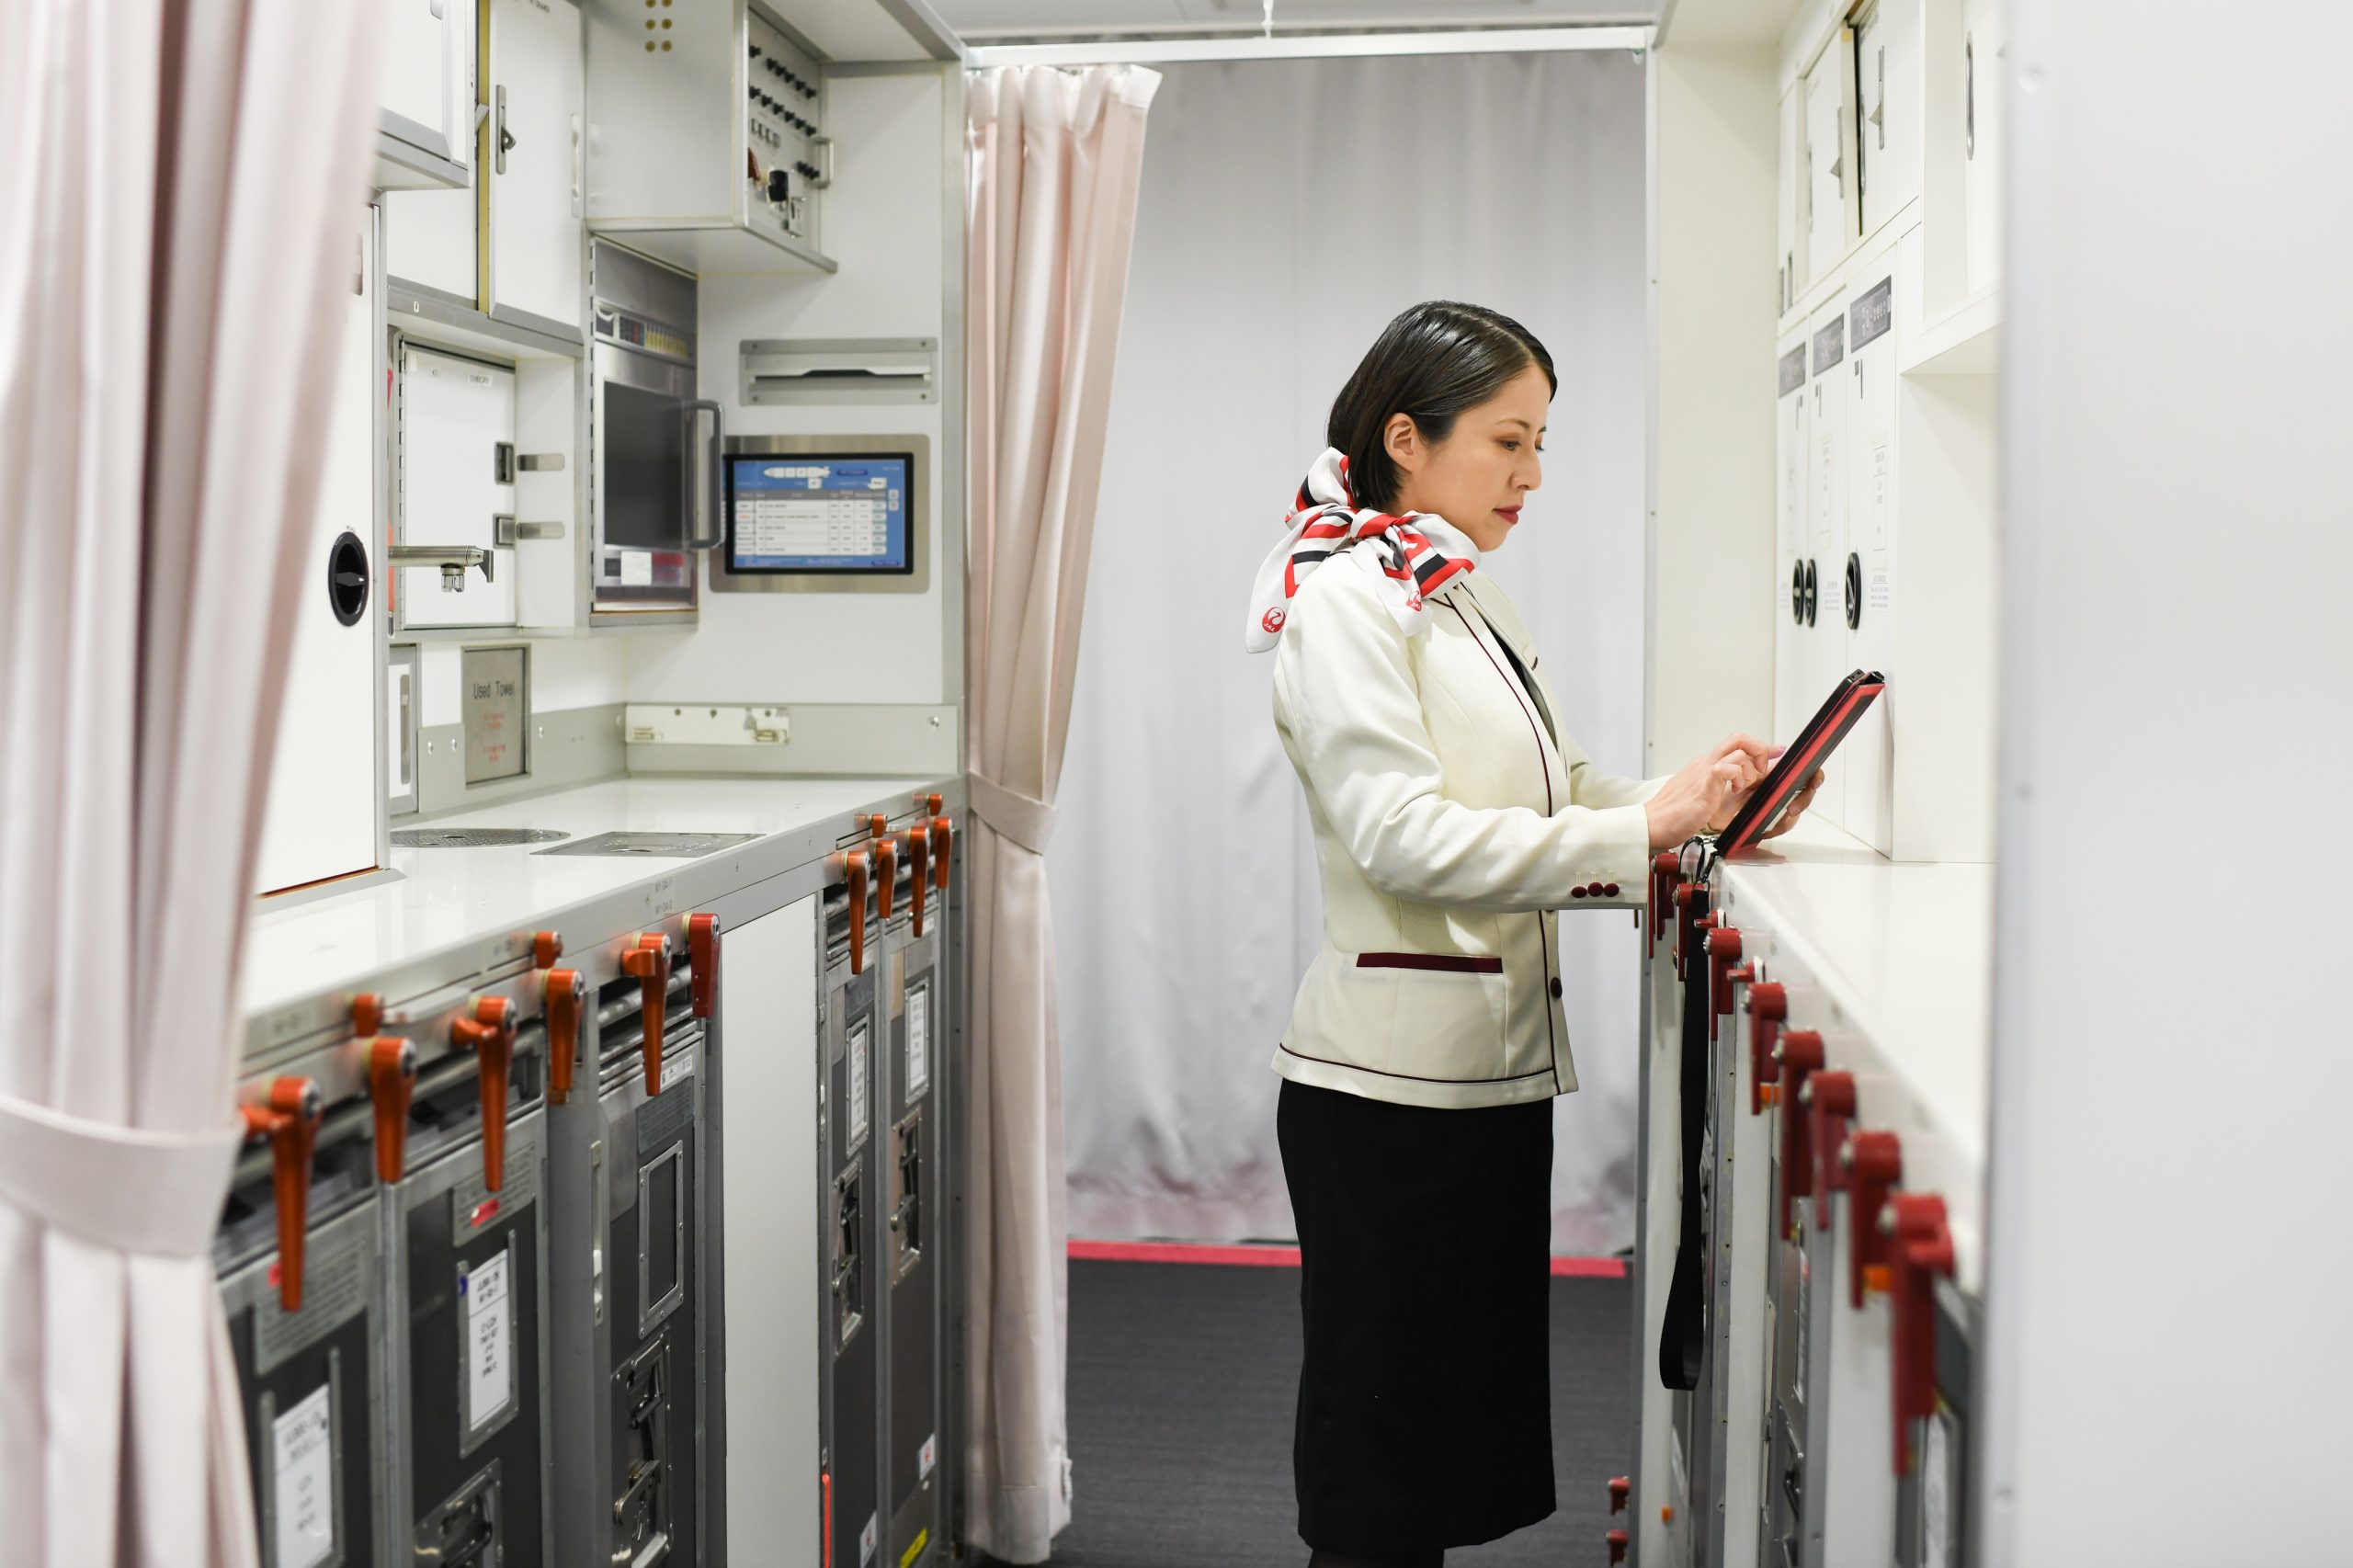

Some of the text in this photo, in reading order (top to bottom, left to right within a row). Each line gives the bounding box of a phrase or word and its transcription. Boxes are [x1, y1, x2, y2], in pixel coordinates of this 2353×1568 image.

[1264, 623, 1276, 631] JAL
[473, 680, 515, 699] Used Towel
